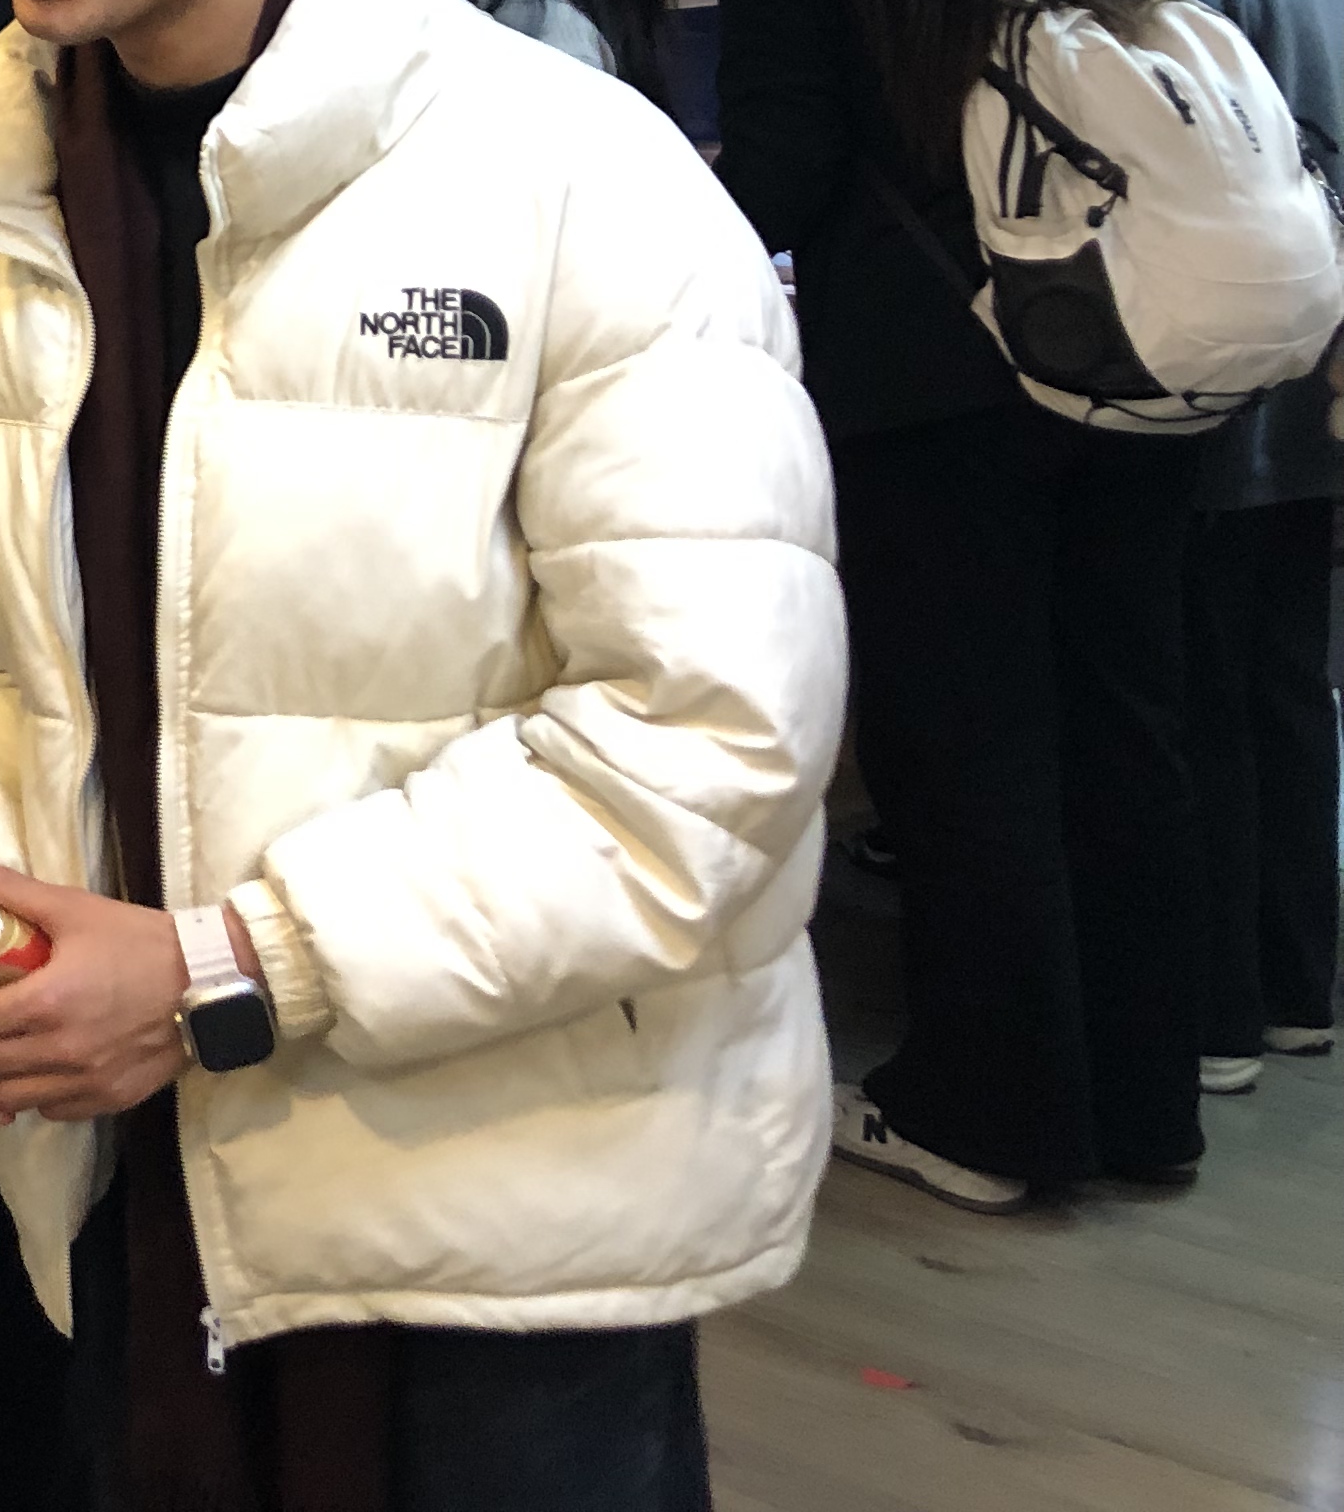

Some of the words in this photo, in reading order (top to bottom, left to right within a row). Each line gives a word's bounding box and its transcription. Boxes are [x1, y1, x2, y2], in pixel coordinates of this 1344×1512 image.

[401, 287, 460, 311] THE
[359, 311, 459, 336] NORTH
[387, 334, 460, 359] FACE
